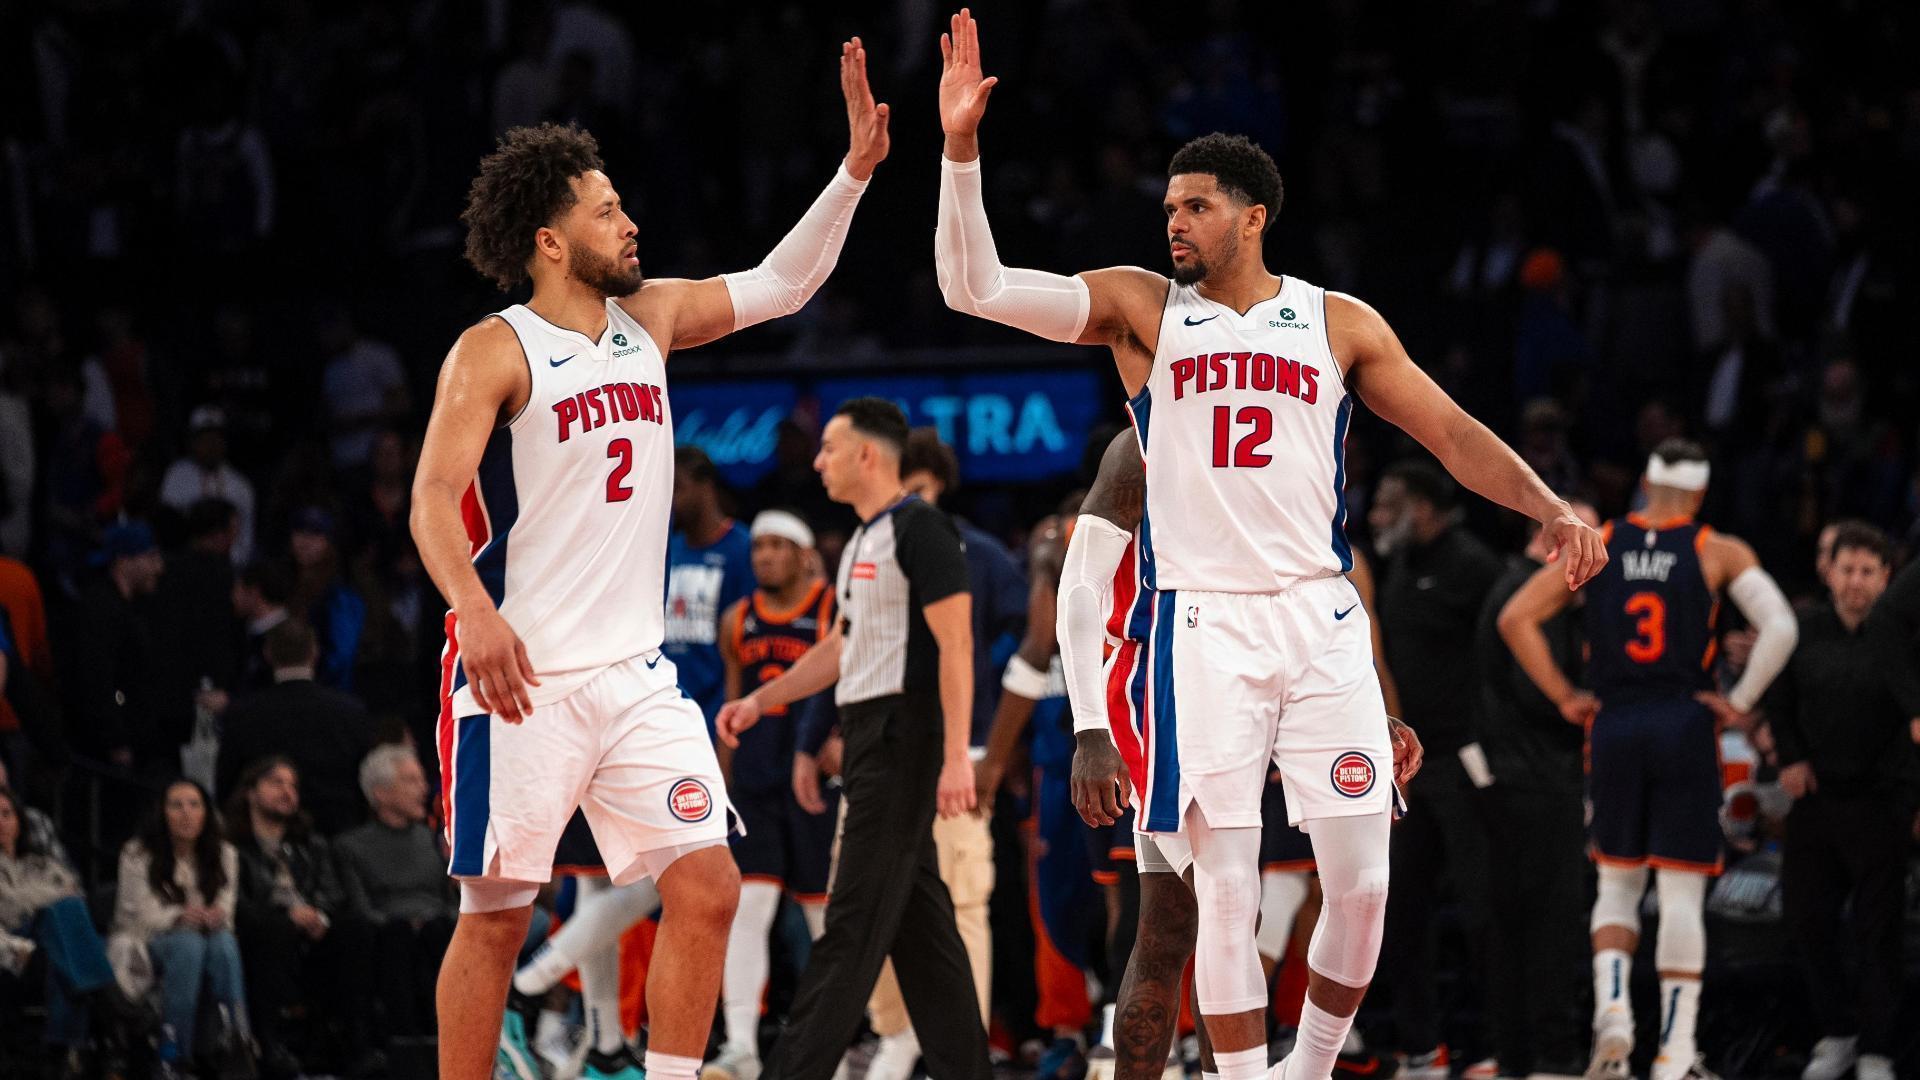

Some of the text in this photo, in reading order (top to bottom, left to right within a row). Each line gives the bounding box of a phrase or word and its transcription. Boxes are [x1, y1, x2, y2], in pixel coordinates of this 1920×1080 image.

[1268, 320, 1310, 330] StockX
[1170, 352, 1320, 405] PISTONS
[552, 382, 663, 443] PISTONS
[1212, 406, 1273, 468] 12
[606, 438, 633, 503] 2
[1625, 592, 1665, 662] 3
[1339, 774, 1368, 783] PISTONS
[1340, 767, 1367, 775] DETROIT
